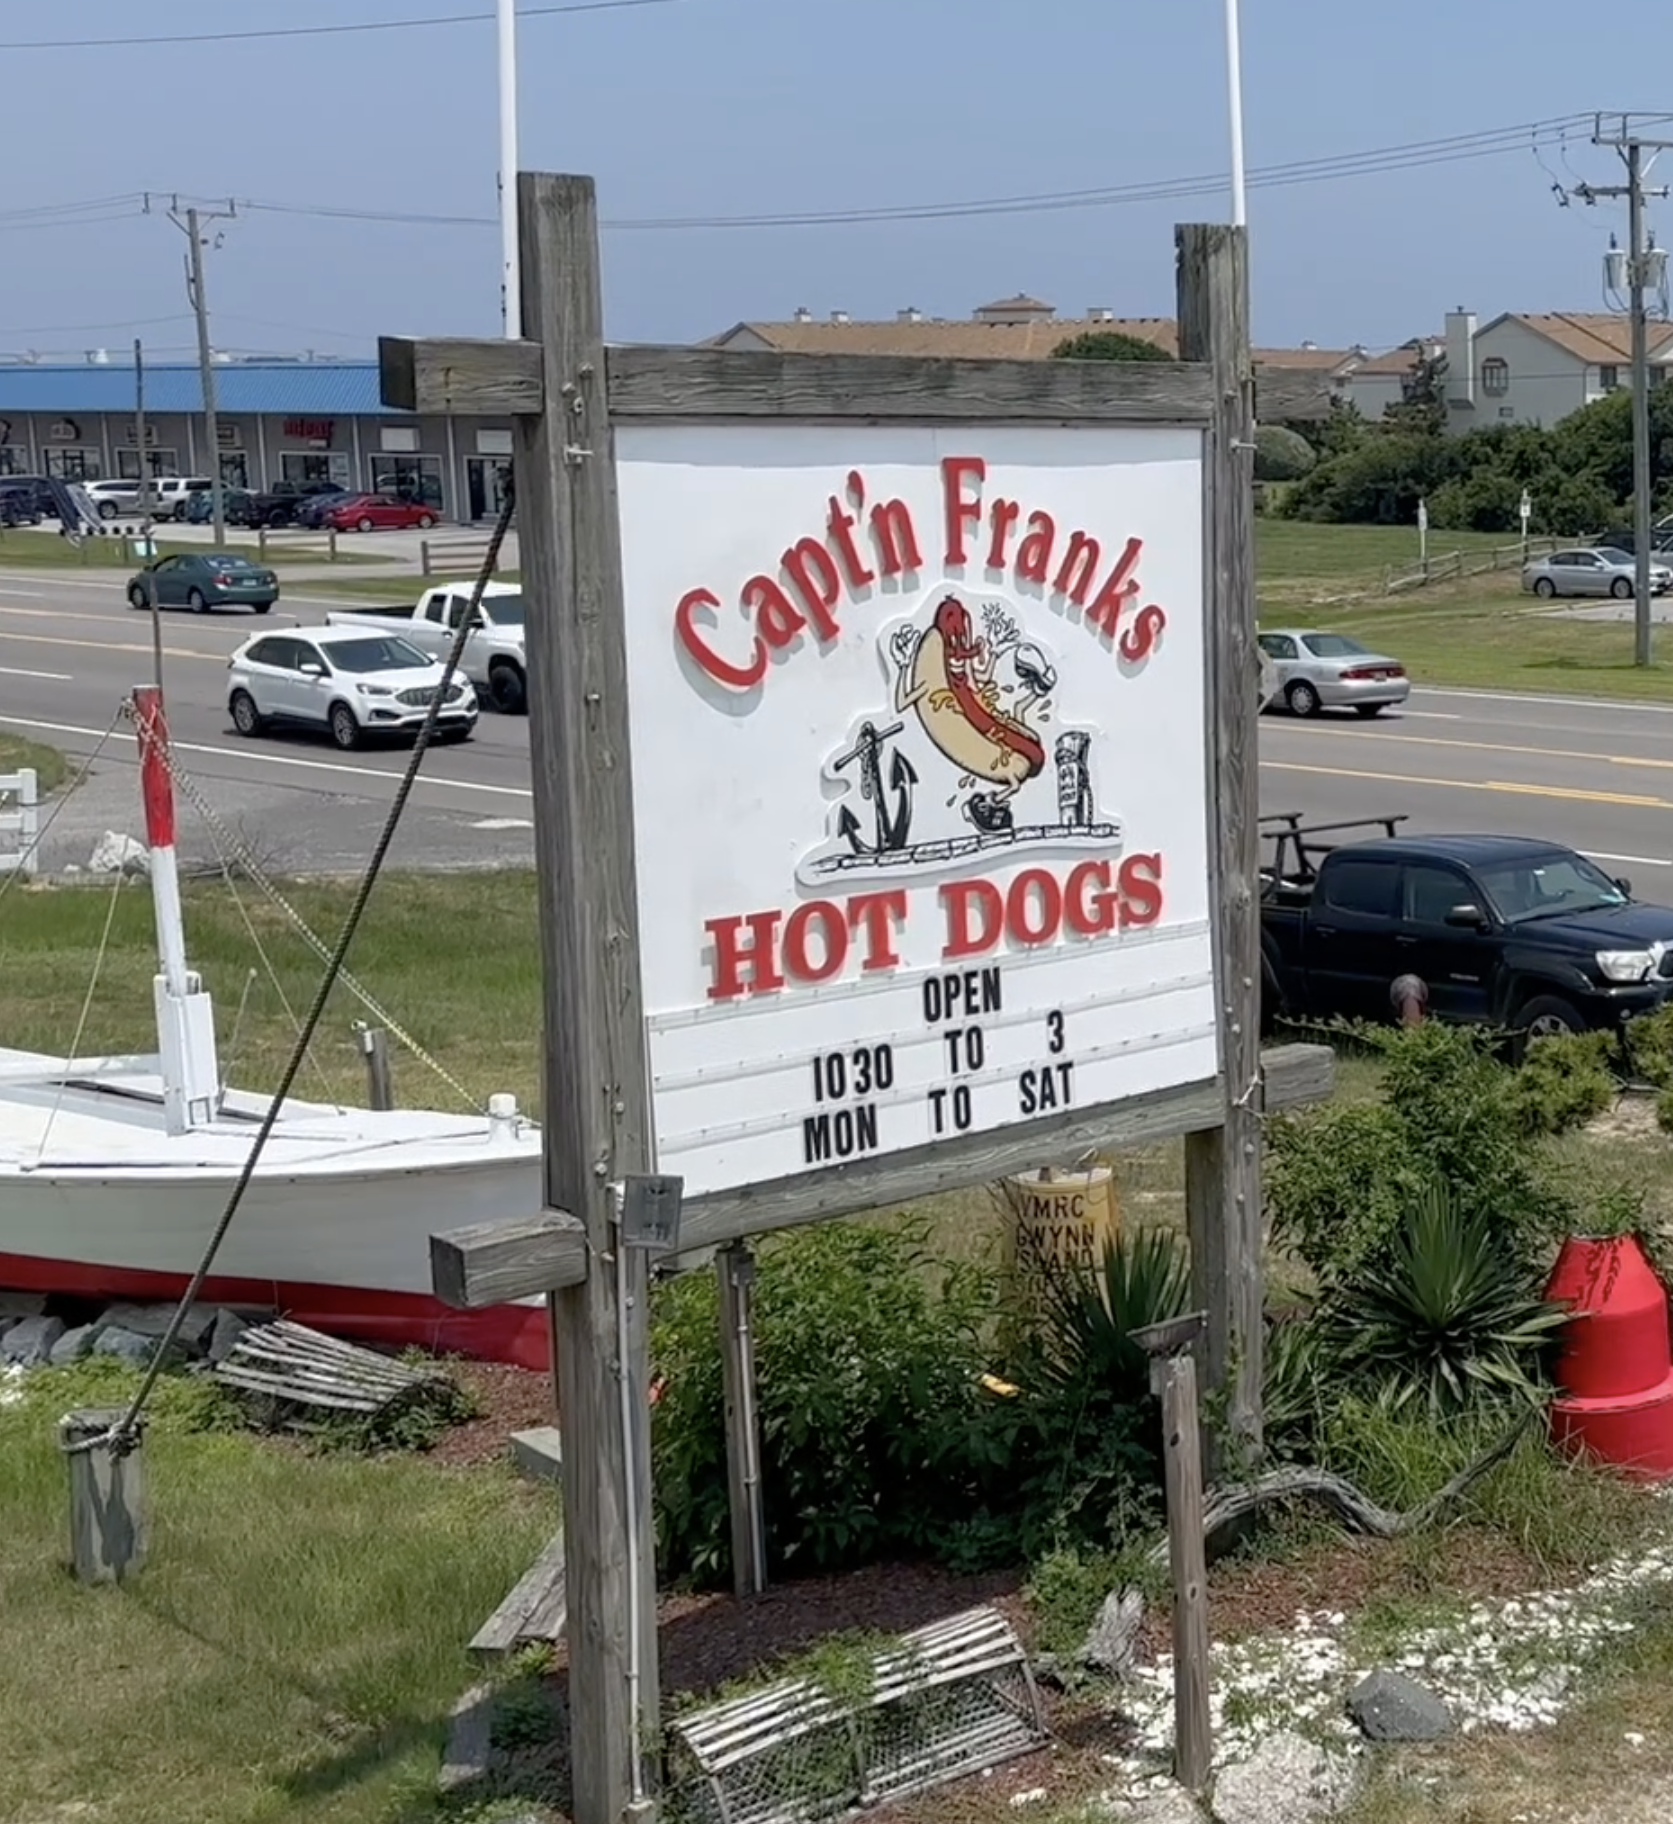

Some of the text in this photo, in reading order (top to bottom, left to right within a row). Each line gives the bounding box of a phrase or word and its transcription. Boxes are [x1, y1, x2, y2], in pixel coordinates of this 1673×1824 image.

[674, 457, 1166, 688] Capt'n Franks
[704, 852, 1164, 999] HOT DOGS
[923, 966, 1002, 1023] OPEN
[813, 1009, 1064, 1102] 1030 TO 3
[803, 1061, 1074, 1164] MON TO SAT
